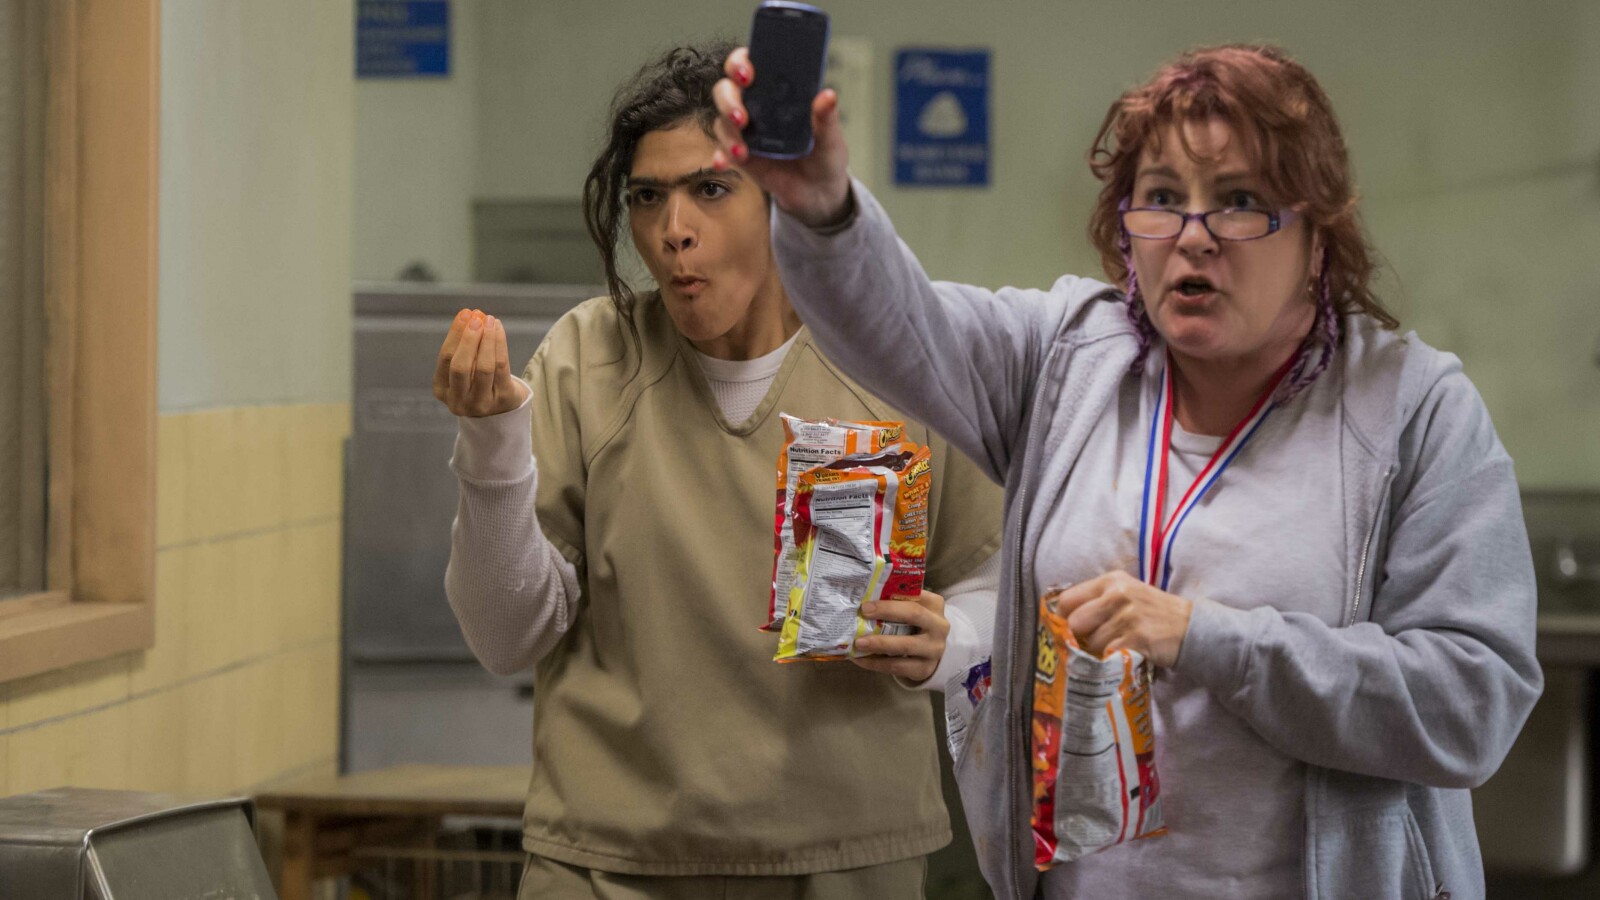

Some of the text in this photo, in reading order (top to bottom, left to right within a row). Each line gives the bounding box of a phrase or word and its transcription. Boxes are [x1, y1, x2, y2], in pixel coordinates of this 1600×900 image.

[789, 446, 819, 455] Nutrition
[815, 492, 869, 502] Nutrition Facts
